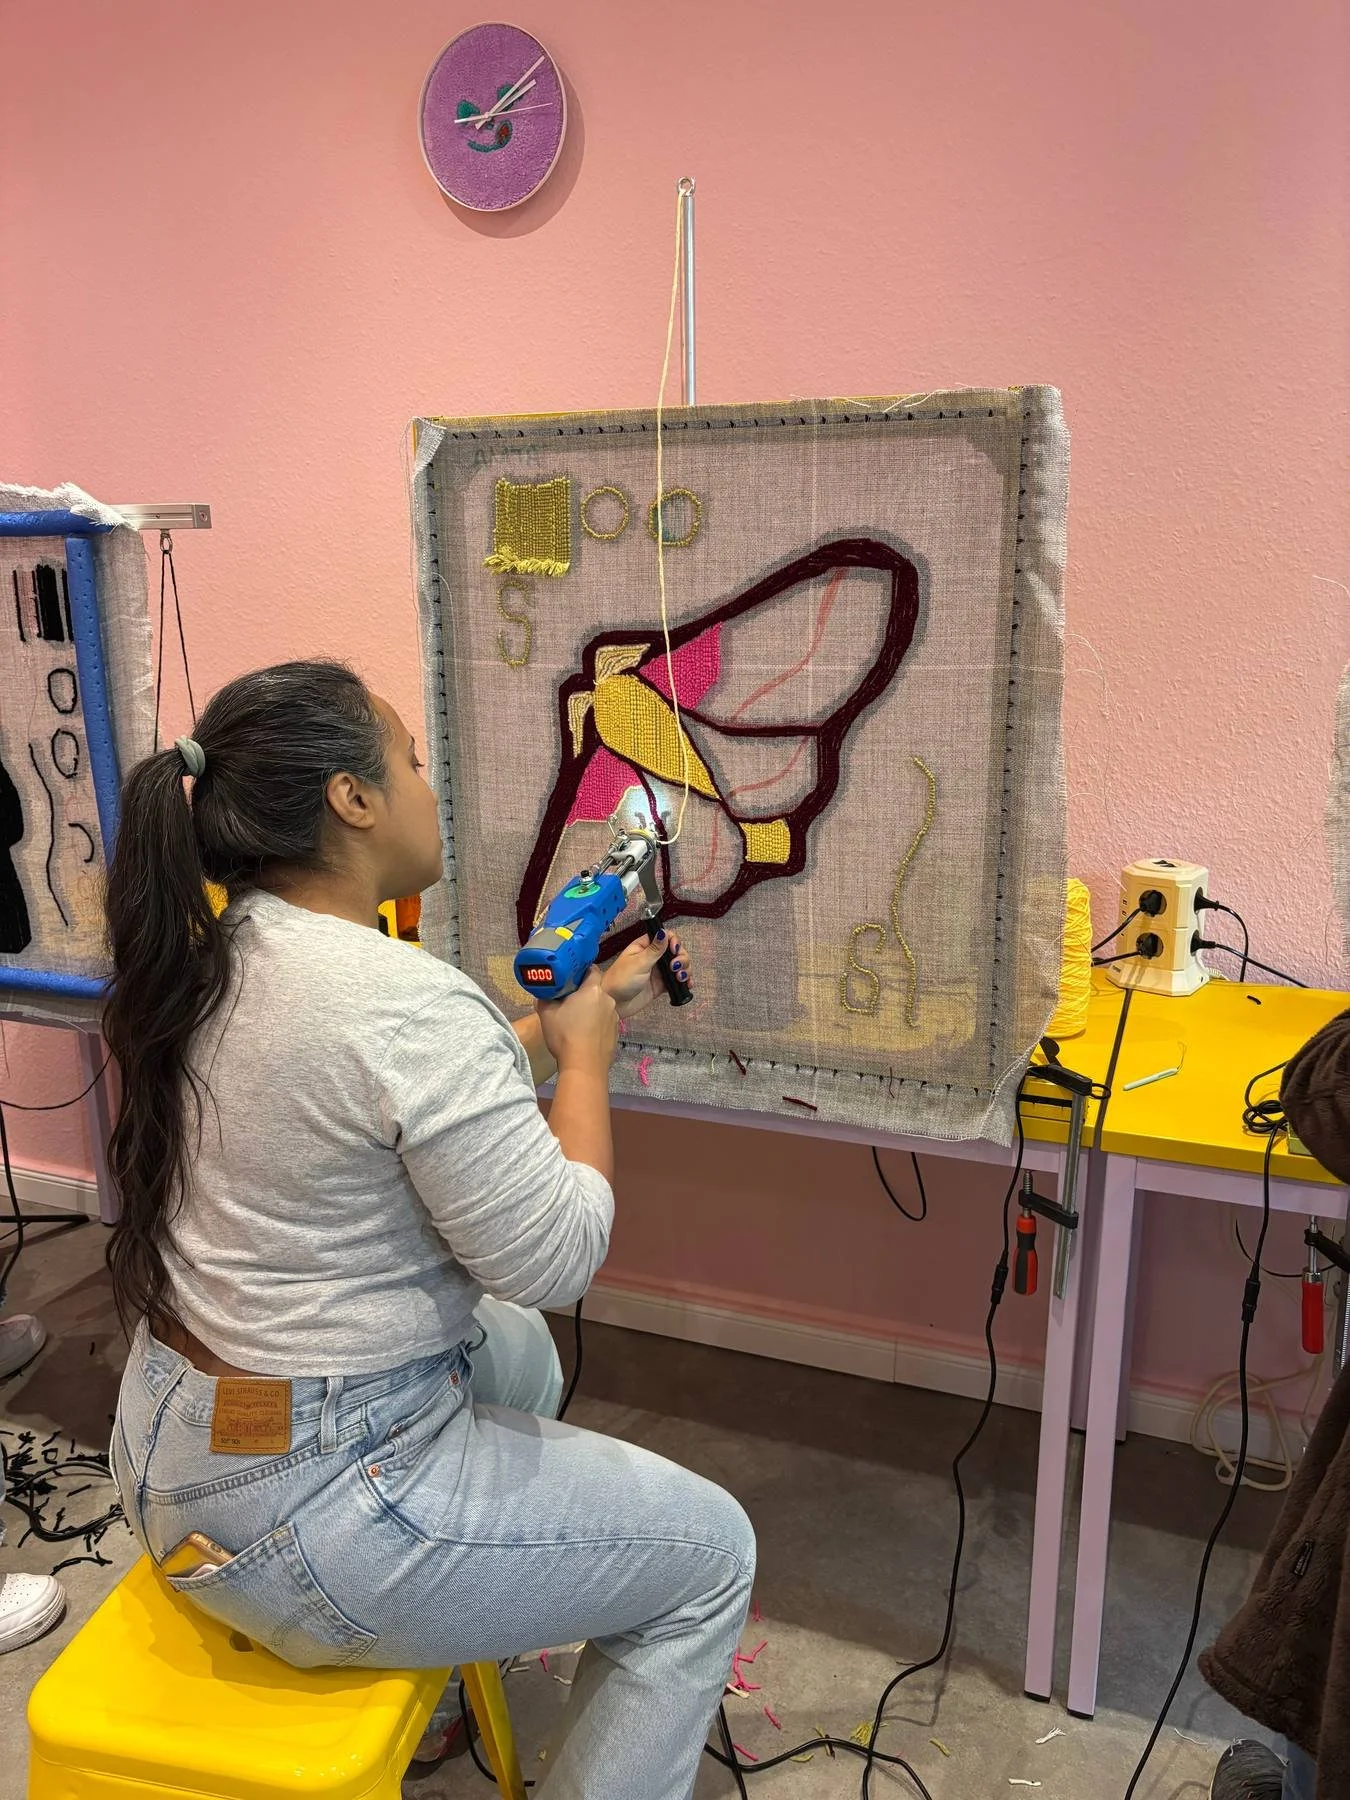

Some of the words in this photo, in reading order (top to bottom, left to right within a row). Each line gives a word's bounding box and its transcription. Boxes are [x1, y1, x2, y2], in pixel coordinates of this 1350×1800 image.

[527, 968, 552, 981] 1000
[223, 1387, 235, 1396] LEVI
[236, 1386, 262, 1397] STRAUSS
